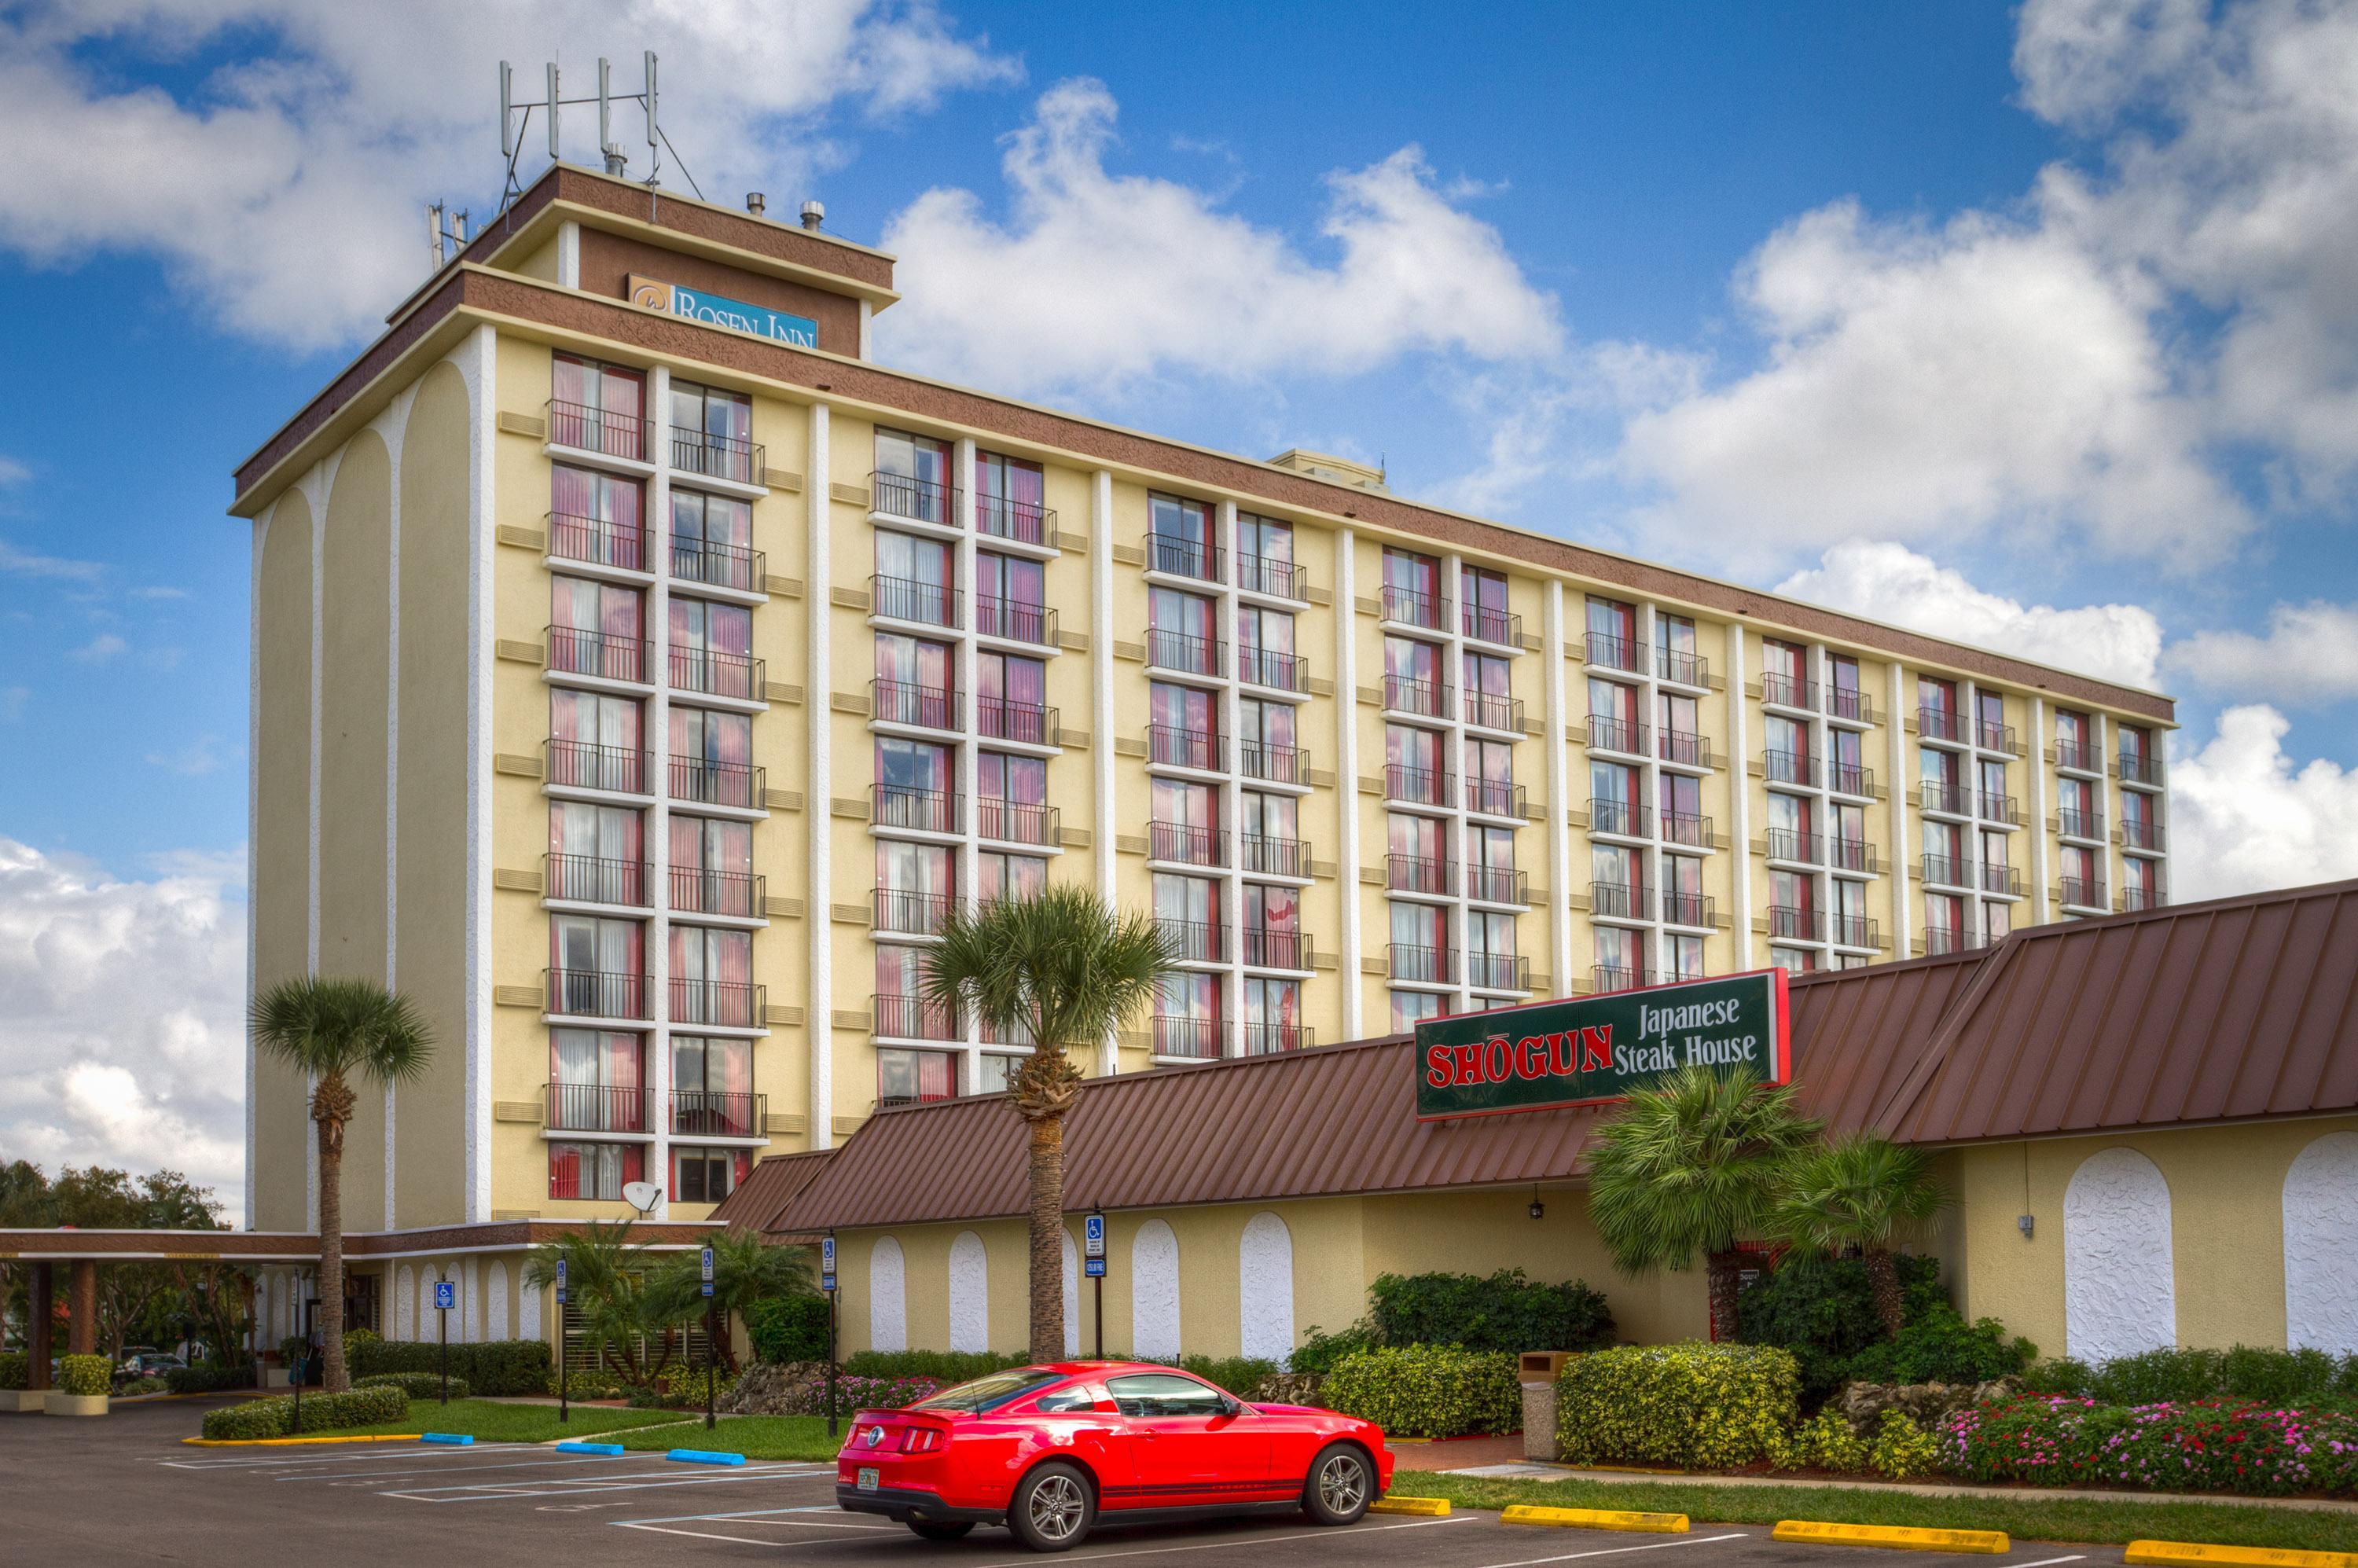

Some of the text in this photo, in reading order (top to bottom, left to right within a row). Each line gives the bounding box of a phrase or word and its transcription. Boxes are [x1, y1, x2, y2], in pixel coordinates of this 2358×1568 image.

[678, 292, 814, 349] ROSEN INN
[1638, 998, 1740, 1041] Japanese
[1614, 1034, 1757, 1075] Steak House
